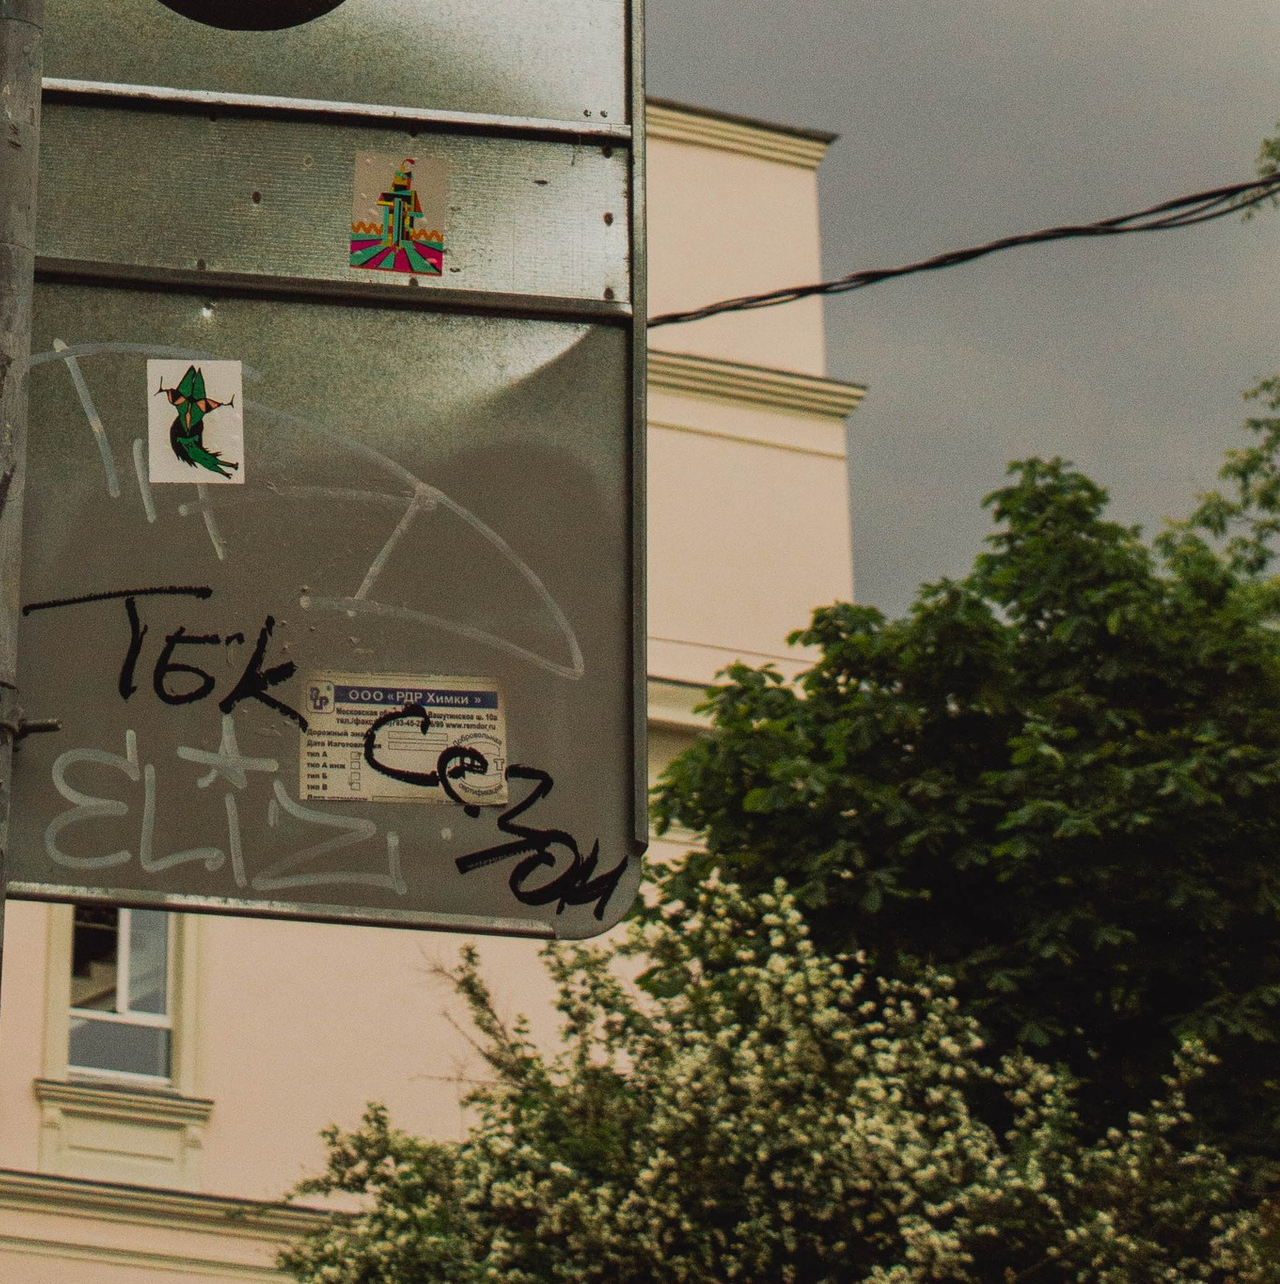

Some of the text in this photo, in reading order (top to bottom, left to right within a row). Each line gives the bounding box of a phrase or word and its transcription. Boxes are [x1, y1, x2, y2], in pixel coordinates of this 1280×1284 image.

[349, 689, 384, 702] ООО
[427, 692, 469, 705] Химки
[336, 707, 379, 717] Московская
[307, 728, 349, 738] Дорожный
[307, 739, 326, 748] Дата
